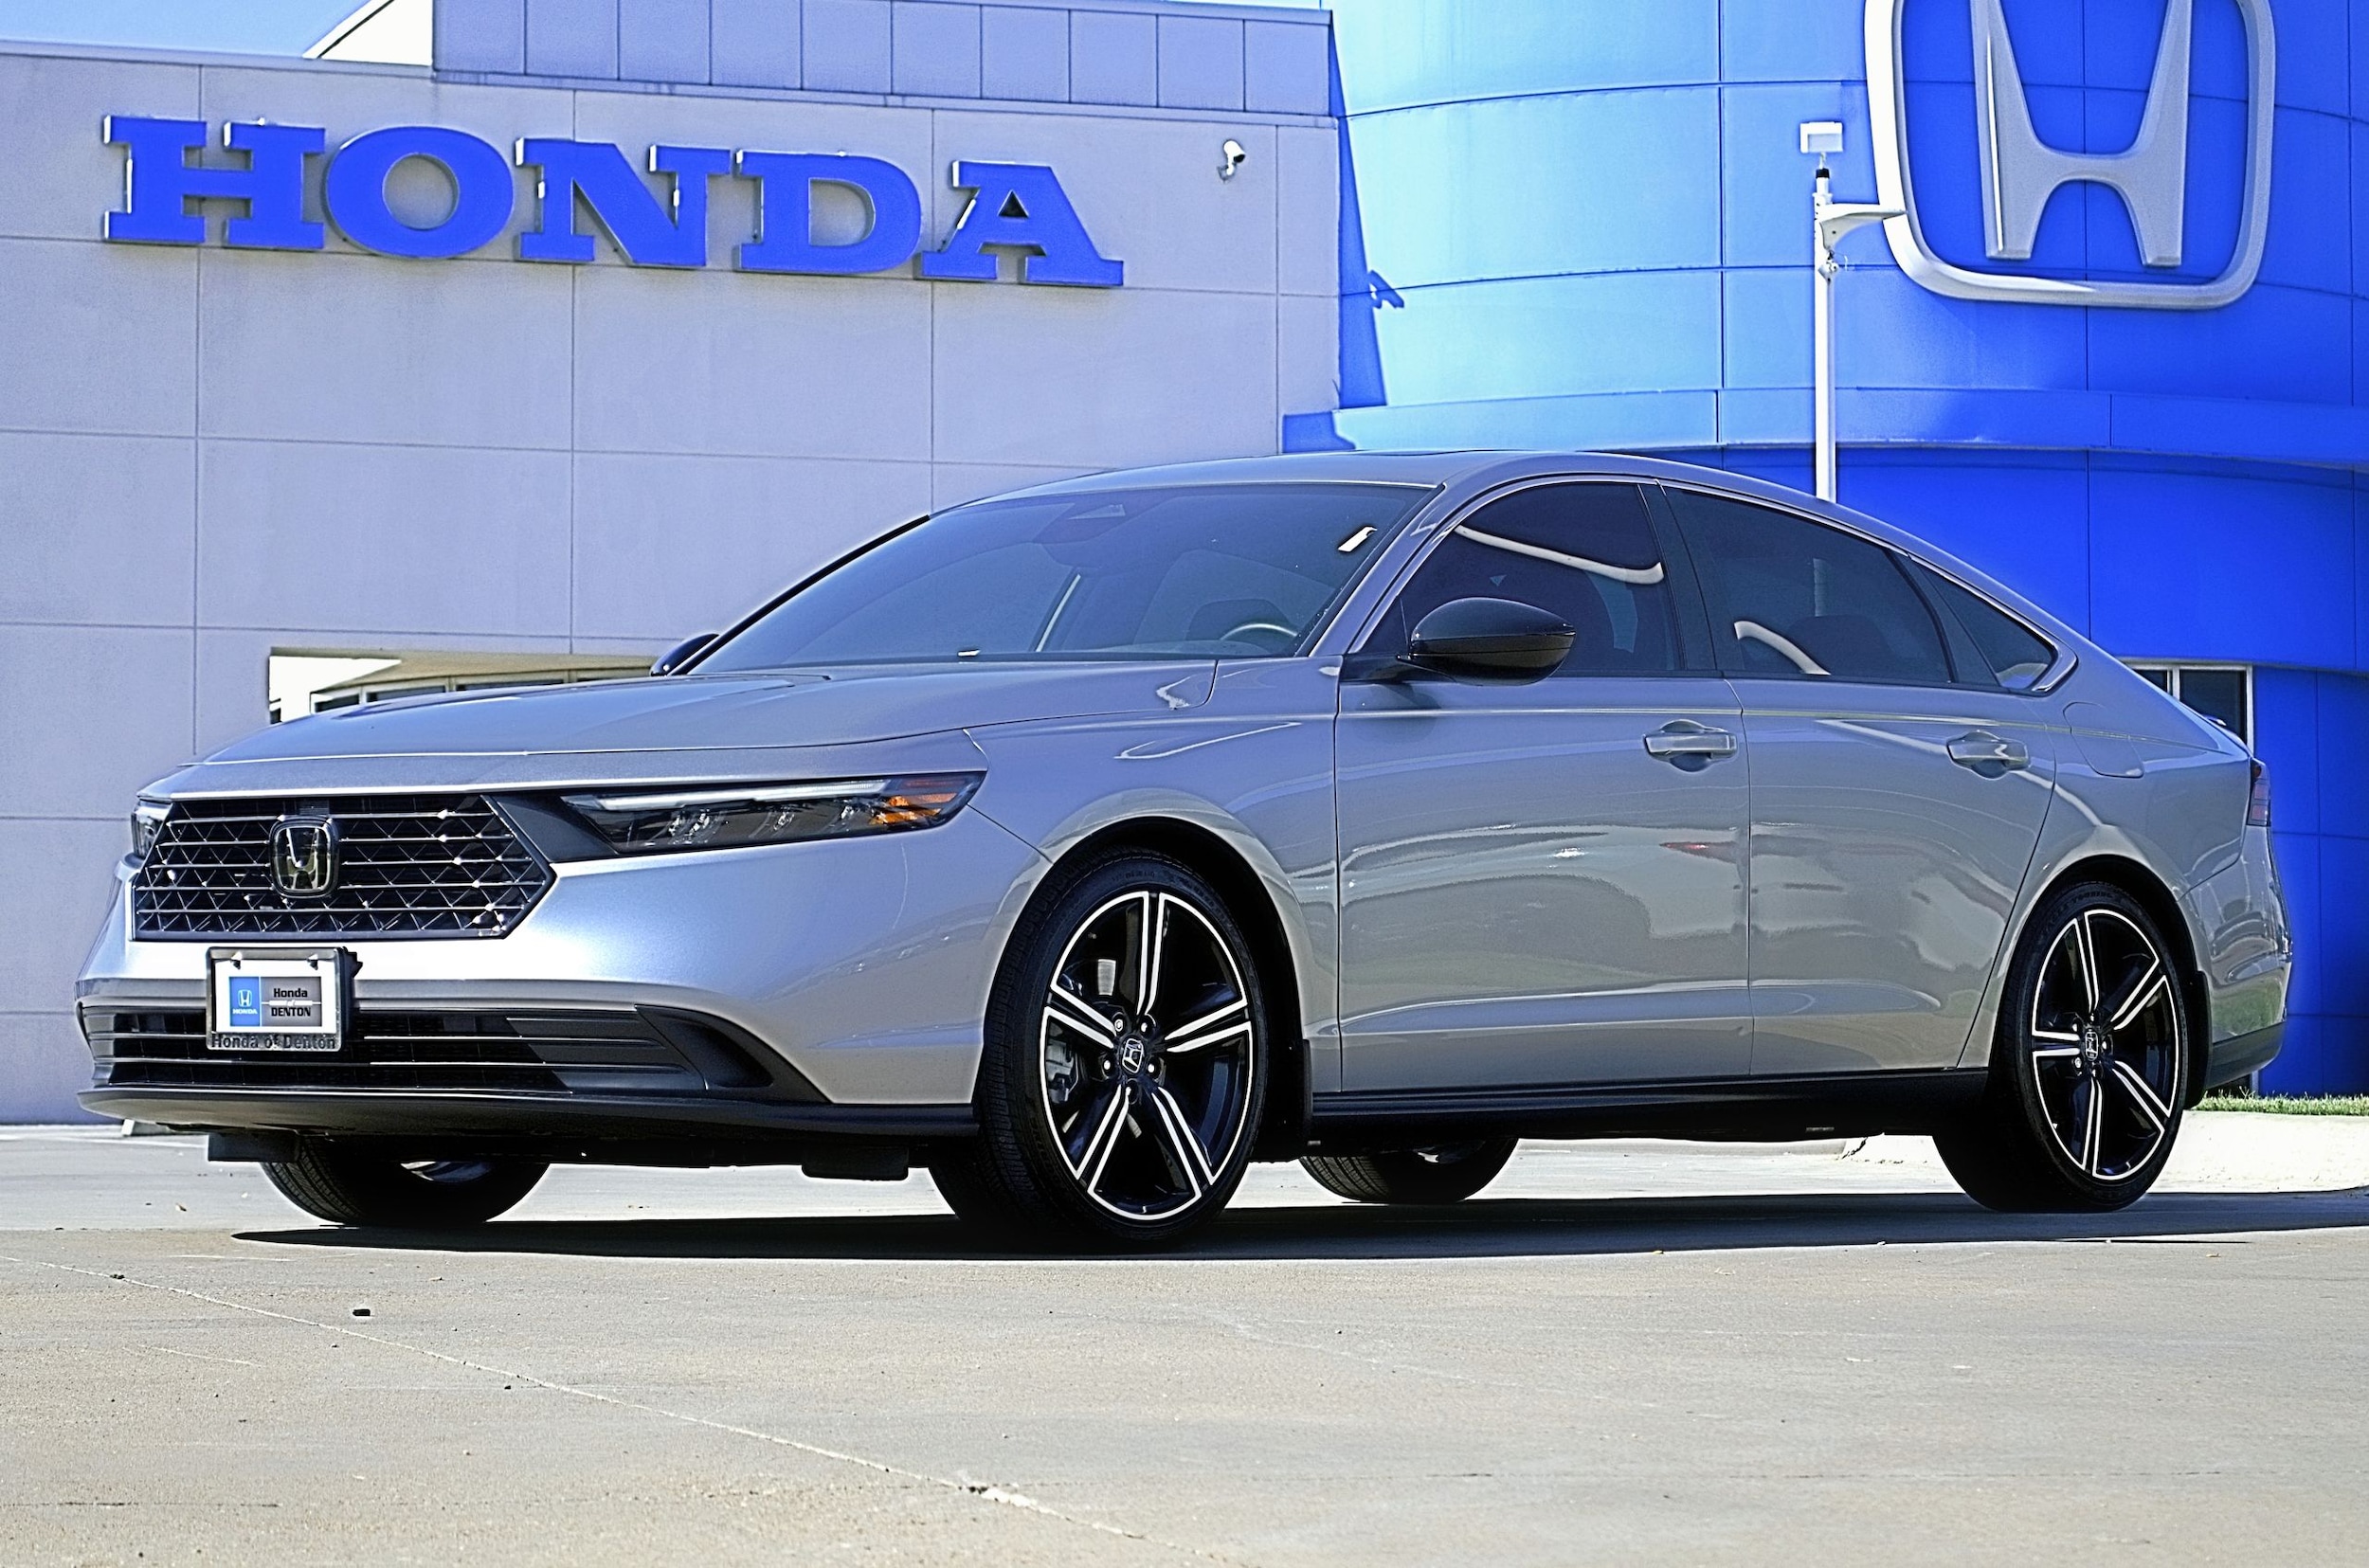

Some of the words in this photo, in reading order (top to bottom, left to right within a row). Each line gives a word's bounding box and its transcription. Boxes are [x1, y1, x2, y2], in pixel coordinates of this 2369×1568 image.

[102, 115, 1124, 288] HONDA
[274, 988, 308, 998] Honda
[271, 1007, 312, 1017] DENTON
[211, 1034, 260, 1049] Honda
[283, 1035, 335, 1050] Denton
